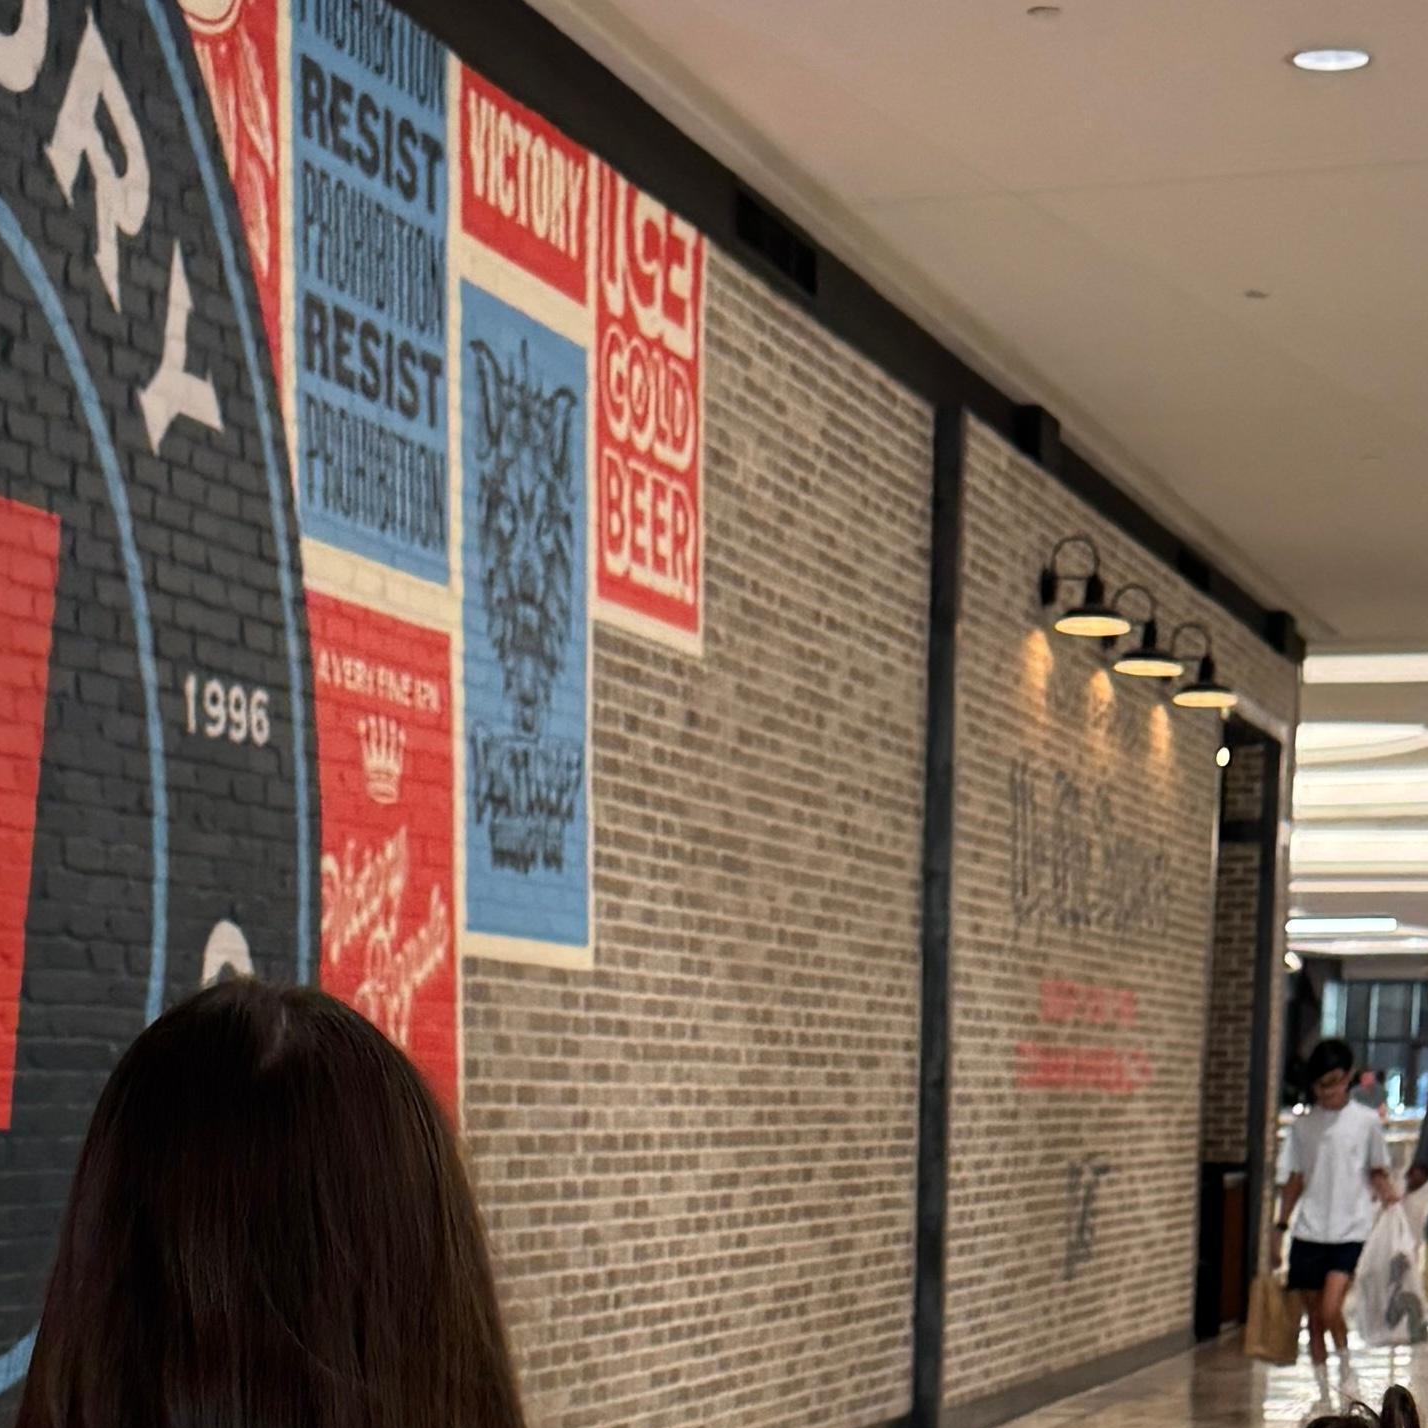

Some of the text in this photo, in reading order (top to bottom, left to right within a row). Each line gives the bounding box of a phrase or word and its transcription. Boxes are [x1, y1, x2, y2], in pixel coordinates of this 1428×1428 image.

[300, 53, 444, 212] RESIST
[469, 87, 586, 262] VICTORY
[301, 160, 447, 342] PROHIBITION
[302, 290, 444, 430] RESIST
[601, 325, 695, 474] COLD
[306, 393, 449, 552] PROHIBITION
[602, 447, 695, 606] BEER
[183, 672, 271, 747] 1996
